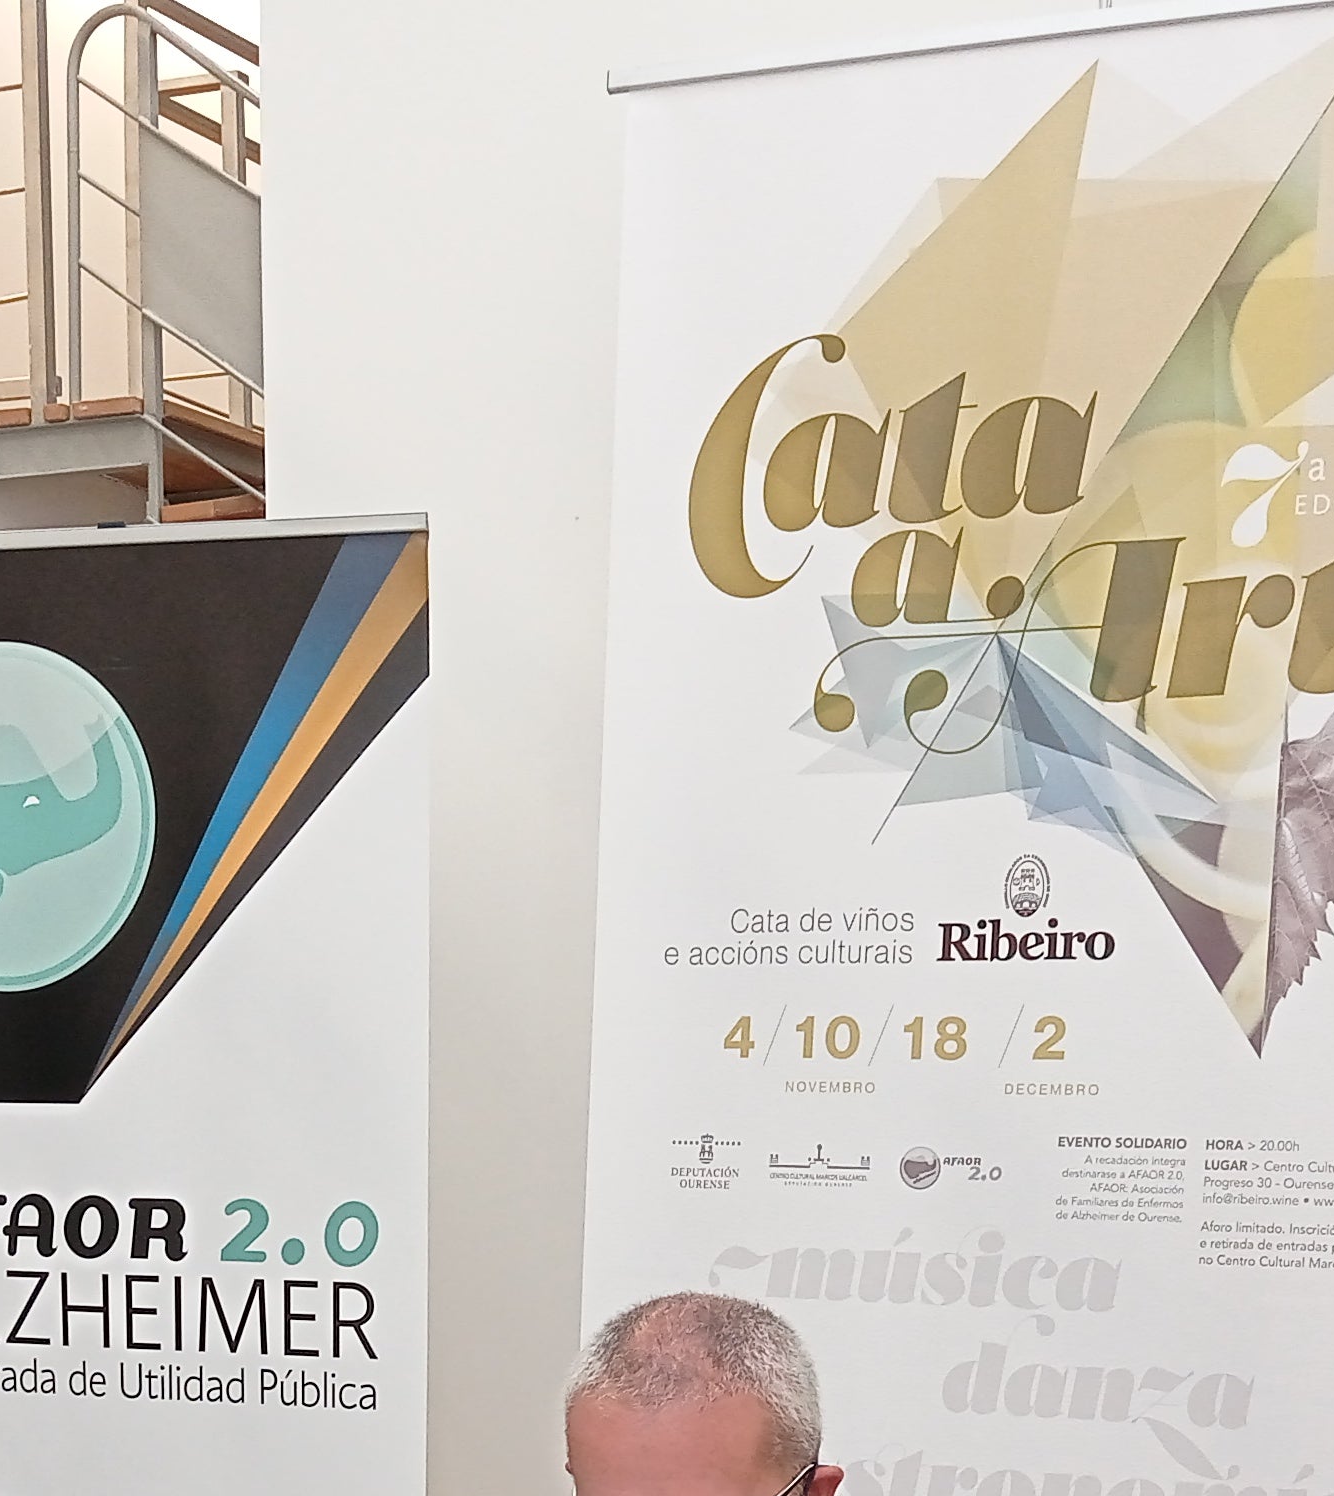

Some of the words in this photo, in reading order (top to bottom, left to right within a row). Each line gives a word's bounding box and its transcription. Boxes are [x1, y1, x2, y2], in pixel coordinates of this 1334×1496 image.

[688, 333, 1099, 599] Cata
[730, 907, 790, 934] Cata
[799, 907, 833, 933] de
[841, 907, 915, 933] viños
[936, 917, 1116, 963] Ribeiro
[663, 947, 680, 966] e
[688, 940, 789, 966] accións
[797, 939, 914, 965] culturais
[723, 1015, 756, 1060] 4
[795, 1015, 861, 1060] 10
[902, 1015, 968, 1061] 18
[1032, 1015, 1067, 1061] 2
[785, 1080, 876, 1095] NOVEMBRO
[1004, 1082, 1100, 1097] DECEMBRO
[1057, 1135, 1112, 1149] EVENTO
[1114, 1136, 1188, 1150] SOLIDARIO
[1205, 1139, 1244, 1152] HORA
[1259, 1139, 1300, 1153] 20.00h
[942, 1156, 982, 1167] AFAOR
[1203, 1159, 1247, 1172] LUGAR
[1263, 1160, 1305, 1174] Centro
[671, 1166, 740, 1179] DEPUTACIÓN
[968, 1166, 1002, 1182] 2.0
[1127, 1168, 1165, 1181] AFAOR
[679, 1178, 730, 1190] OURENSE
[1130, 1183, 1185, 1195] Asociación
[1203, 1177, 1254, 1191] Progreso
[1256, 1176, 1272, 1189] 30
[1283, 1177, 1334, 1191] Ourense
[1055, 1195, 1068, 1207] de
[1070, 1195, 1119, 1208] Familiares
[1136, 1197, 1184, 1210] Enfermos
[1202, 1192, 1300, 1207] info@ribeiro.wine
[1055, 1209, 1068, 1221] de
[1070, 1209, 1120, 1223] Alzheimer
[1122, 1211, 1135, 1223] de
[219, 1197, 380, 1268] 2.0
[1200, 1221, 1233, 1234] Aforo
[1235, 1221, 1286, 1235] limitado.
[1199, 1241, 1207, 1249] e
[1209, 1237, 1255, 1251] retirada
[1257, 1238, 1273, 1251] de
[1276, 1239, 1329, 1253] entradas
[1198, 1256, 1214, 1266] no
[1216, 1253, 1256, 1267] Centro
[1258, 1254, 1306, 1269] Cultural
[708, 1227, 1123, 1314] música
[67, 1360, 107, 1399] de
[118, 1361, 246, 1405] Utilidad
[259, 1368, 378, 1412] Pública
[941, 1314, 1256, 1455] danza
